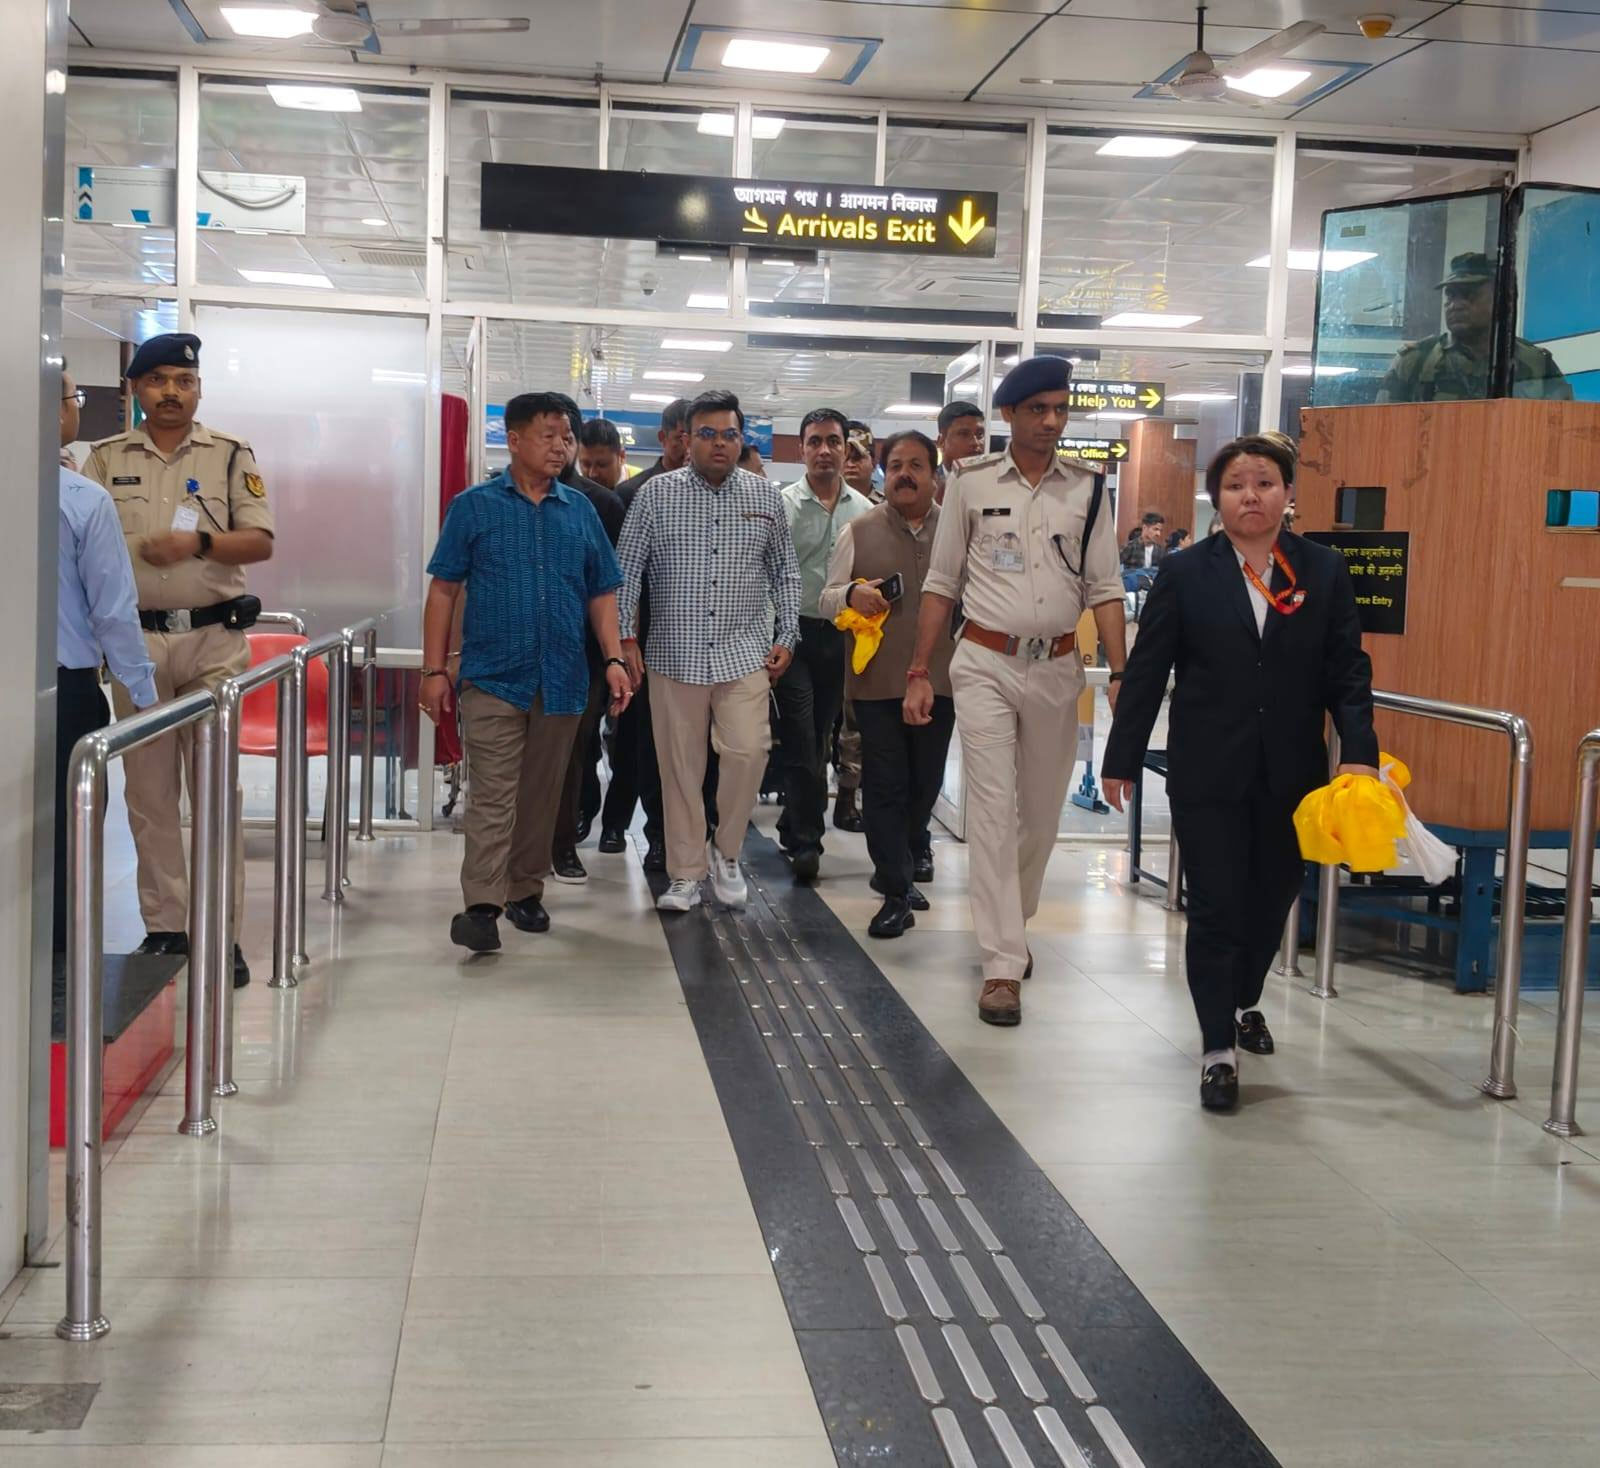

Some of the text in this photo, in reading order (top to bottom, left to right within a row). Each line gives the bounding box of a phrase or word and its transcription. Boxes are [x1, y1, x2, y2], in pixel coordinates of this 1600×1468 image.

[733, 187, 787, 206] আগমন
[793, 190, 818, 207] পথ
[839, 193, 888, 211] आगमन
[891, 192, 938, 213] निकास
[777, 213, 936, 243] Arrivals Exit
[1077, 394, 1108, 410] Help
[1110, 396, 1136, 409] You
[1081, 448, 1109, 459] Office
[1372, 595, 1393, 608] Entry
